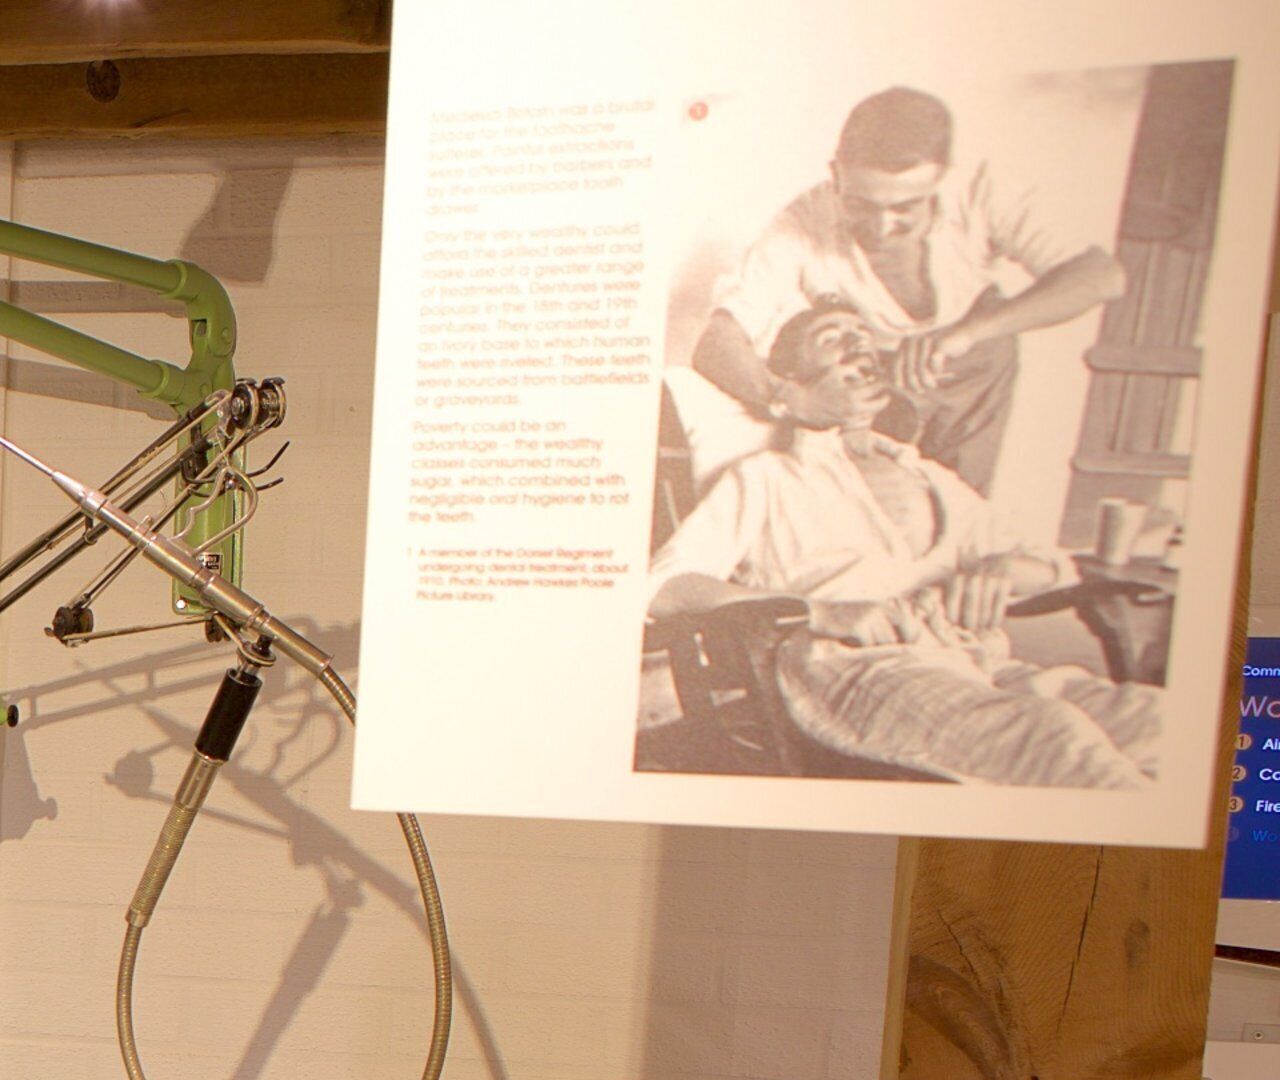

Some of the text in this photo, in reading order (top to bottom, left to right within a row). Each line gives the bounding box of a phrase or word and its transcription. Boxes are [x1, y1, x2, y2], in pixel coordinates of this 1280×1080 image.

[416, 335, 651, 353] an ivory base to which human
[416, 371, 649, 387] were sourced from battlefields
[412, 420, 566, 435] Poverty could be an
[411, 440, 497, 452] advantage
[515, 438, 539, 450] the
[544, 437, 604, 452] wealthy
[411, 456, 601, 470] classes consumed much
[461, 475, 504, 487] which
[508, 474, 590, 487] combined
[596, 472, 626, 485] with
[409, 493, 630, 508] negligible oral hygiene to rot
[408, 511, 431, 523] the
